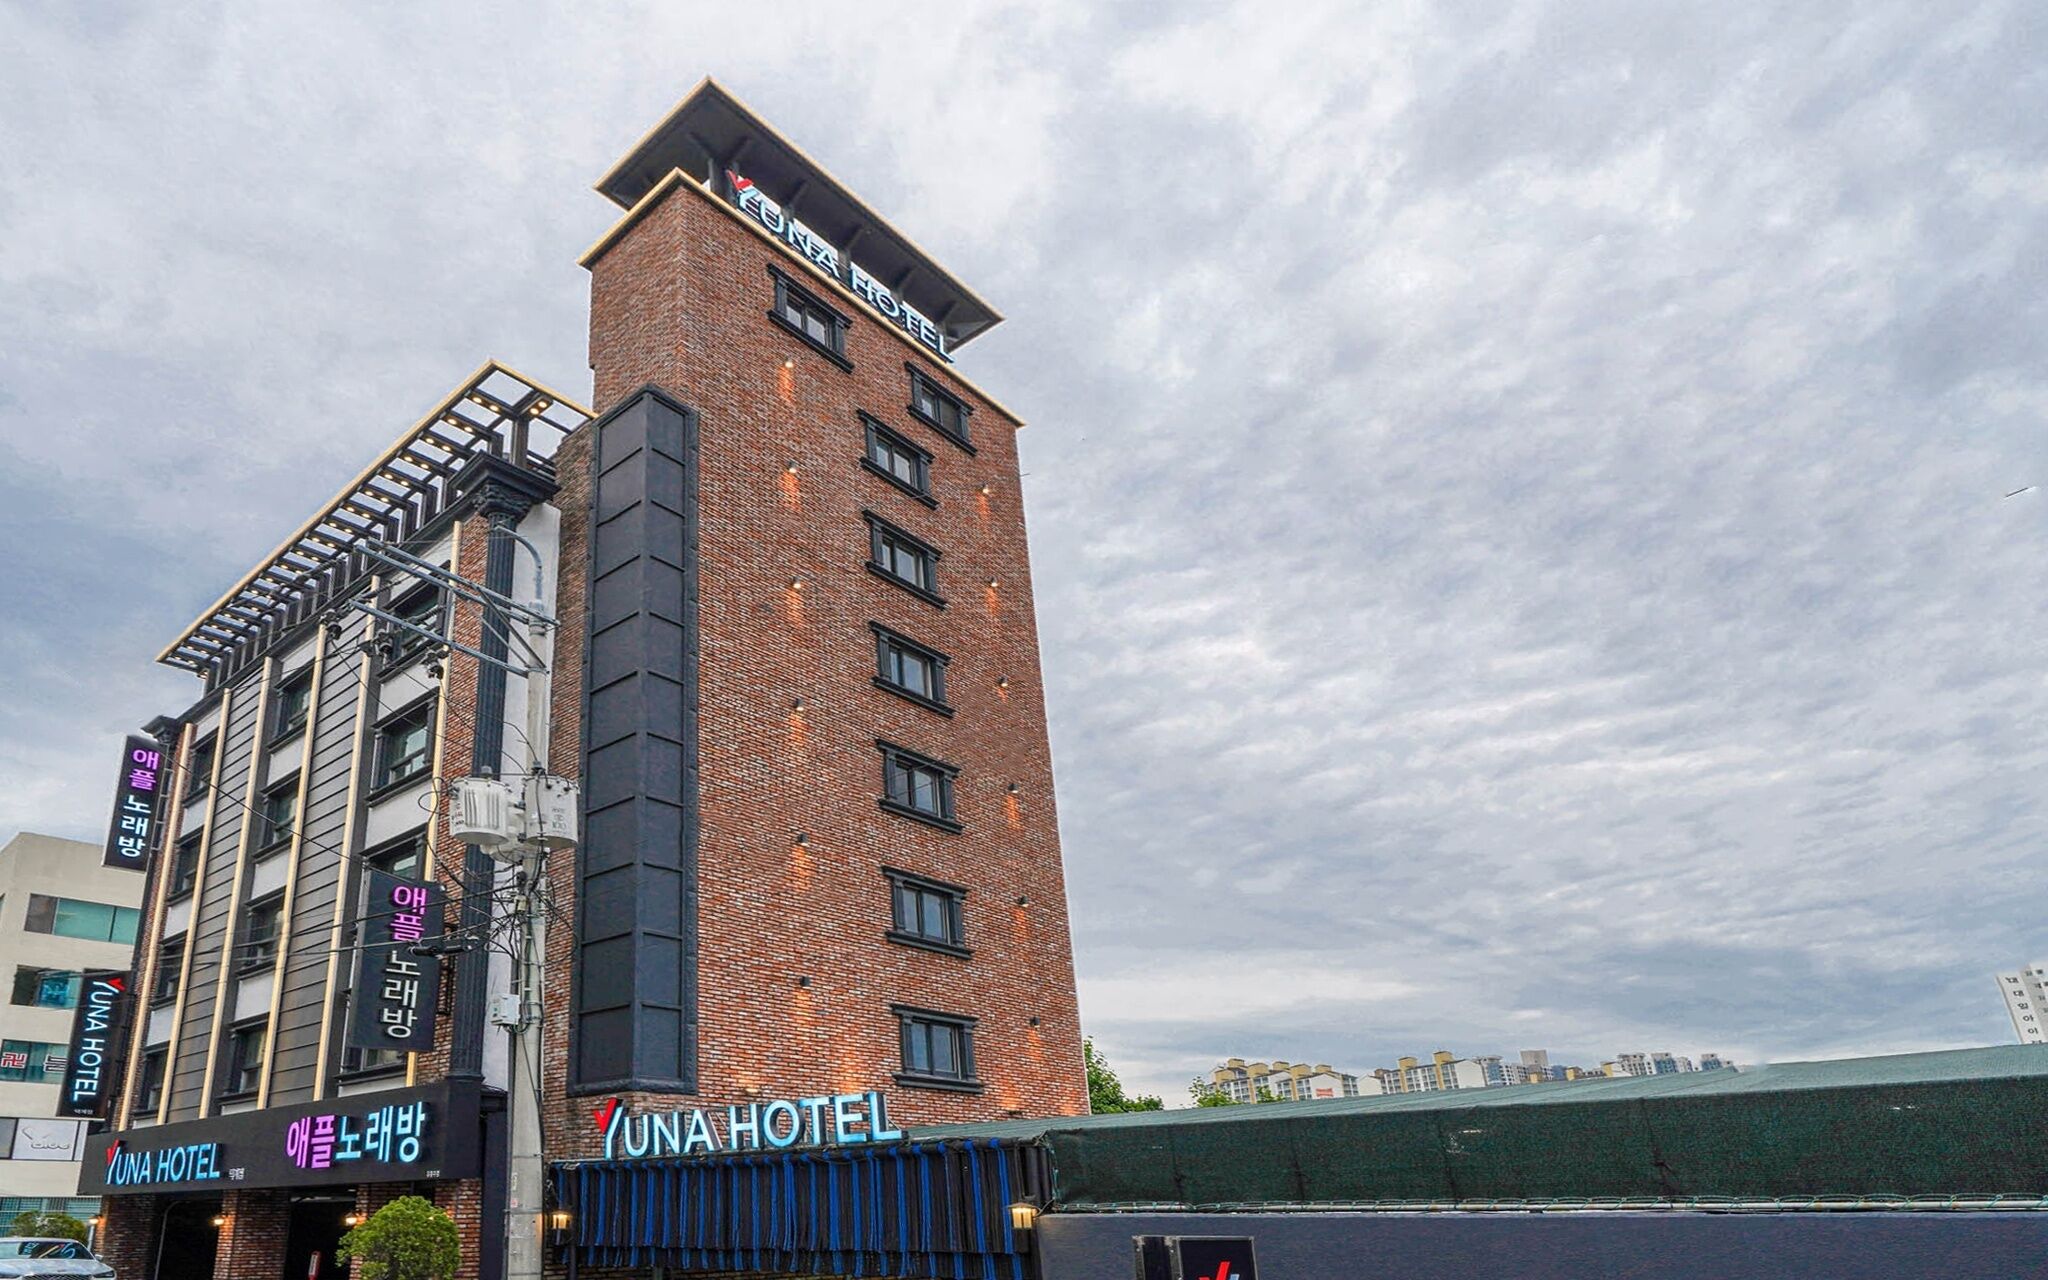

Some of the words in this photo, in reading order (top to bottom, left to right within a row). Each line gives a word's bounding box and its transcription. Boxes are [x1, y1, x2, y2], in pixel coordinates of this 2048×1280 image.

[728, 170, 842, 279] YUNA
[850, 267, 956, 363] HOTEL
[118, 749, 160, 859] 애플노래방
[382, 886, 428, 1039] 애플노래방
[83, 976, 126, 1034] YUNA
[73, 1035, 107, 1102] HOTEL
[286, 1101, 426, 1169] 애플노래방
[594, 1097, 722, 1160] YUNA
[728, 1091, 904, 1150] HOTEL
[105, 1139, 152, 1186] YUNA
[156, 1142, 222, 1183] HOTEL
